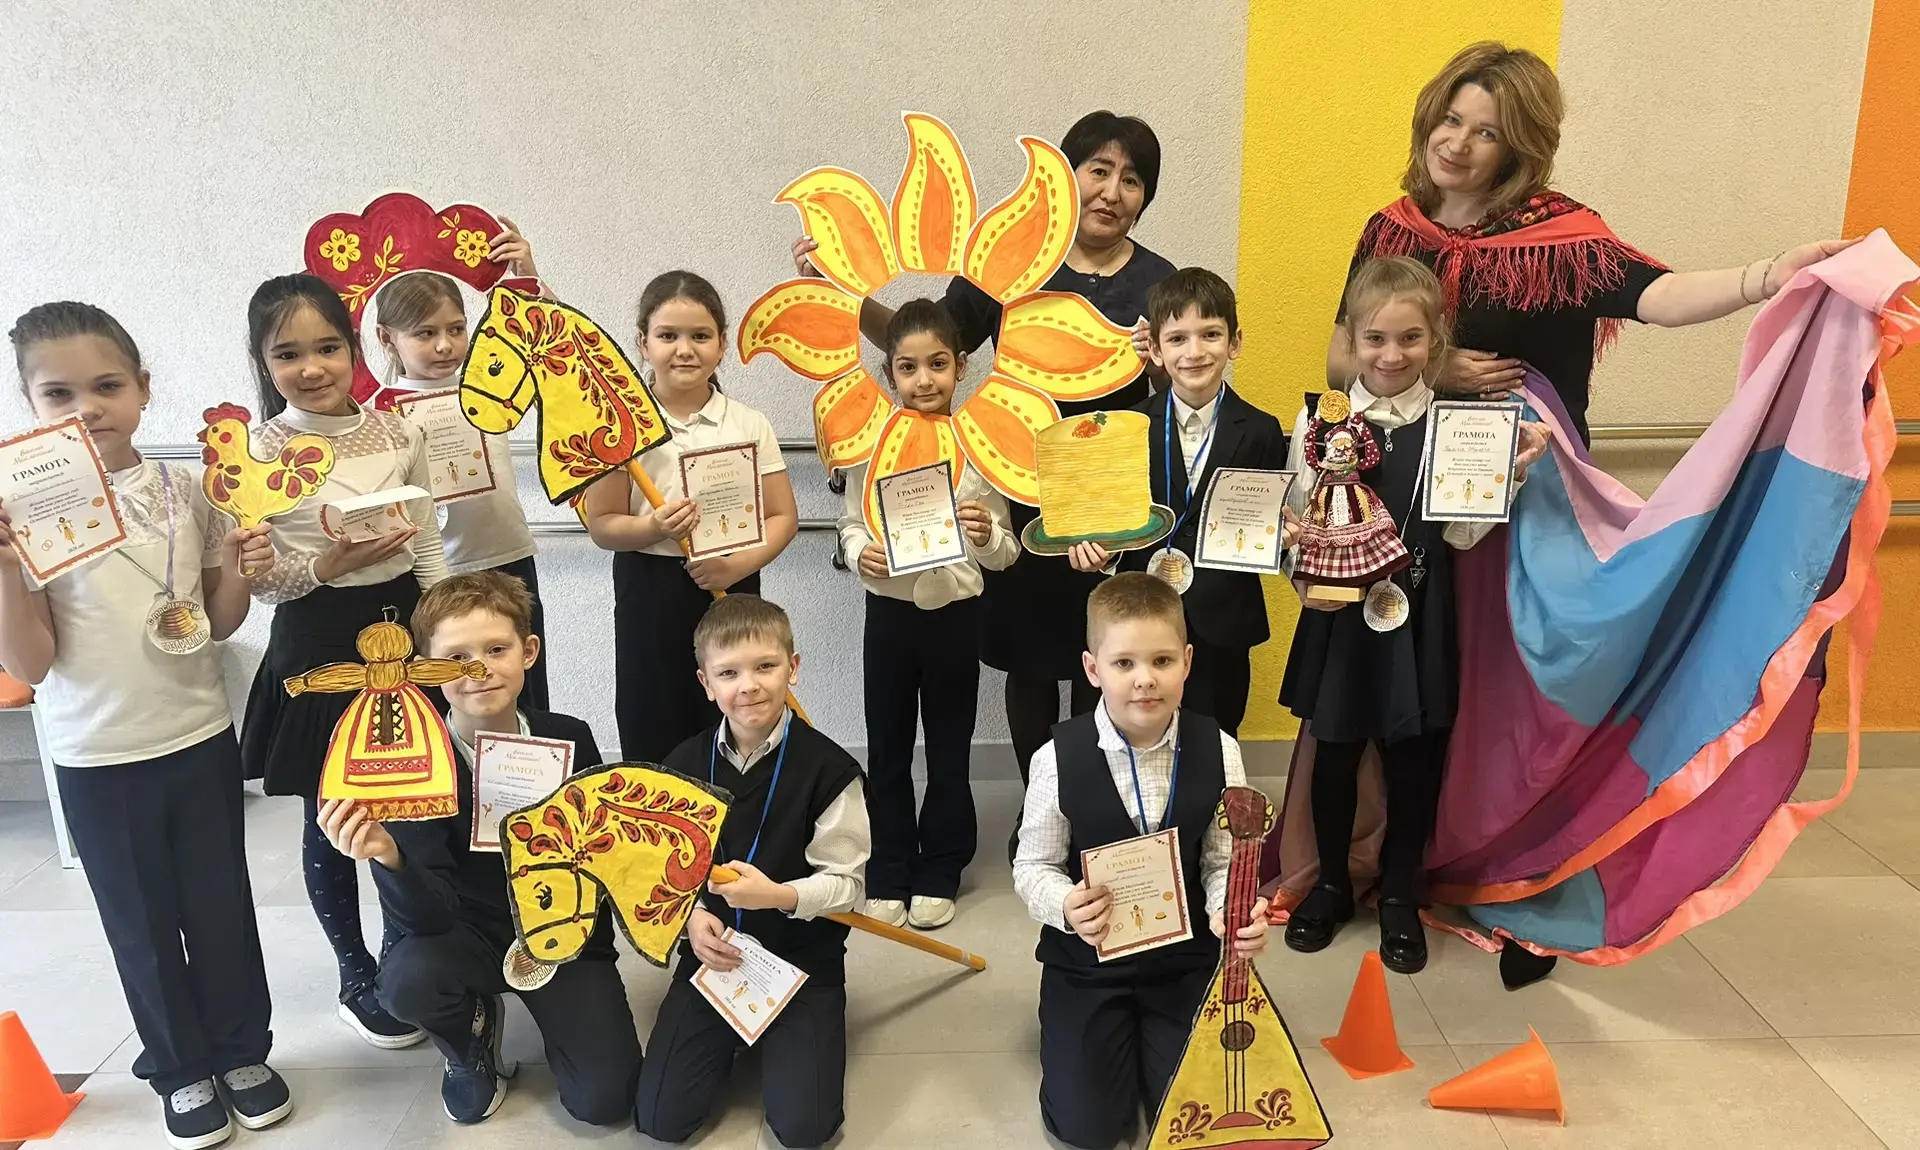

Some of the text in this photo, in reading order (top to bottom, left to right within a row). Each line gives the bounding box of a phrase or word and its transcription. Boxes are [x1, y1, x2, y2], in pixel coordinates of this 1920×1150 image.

[424, 415, 463, 427] ГРАМОТА
[1453, 431, 1496, 439] ГРАМОТА
[12, 457, 71, 482] ГРАМОТА
[702, 471, 740, 483] ГРАМОТА
[896, 485, 935, 497] ГРАМОТА
[1230, 485, 1270, 493] ГРАМОТА
[498, 764, 544, 776] ГРАМОТА
[1106, 855, 1152, 869] ГРАМОТА
